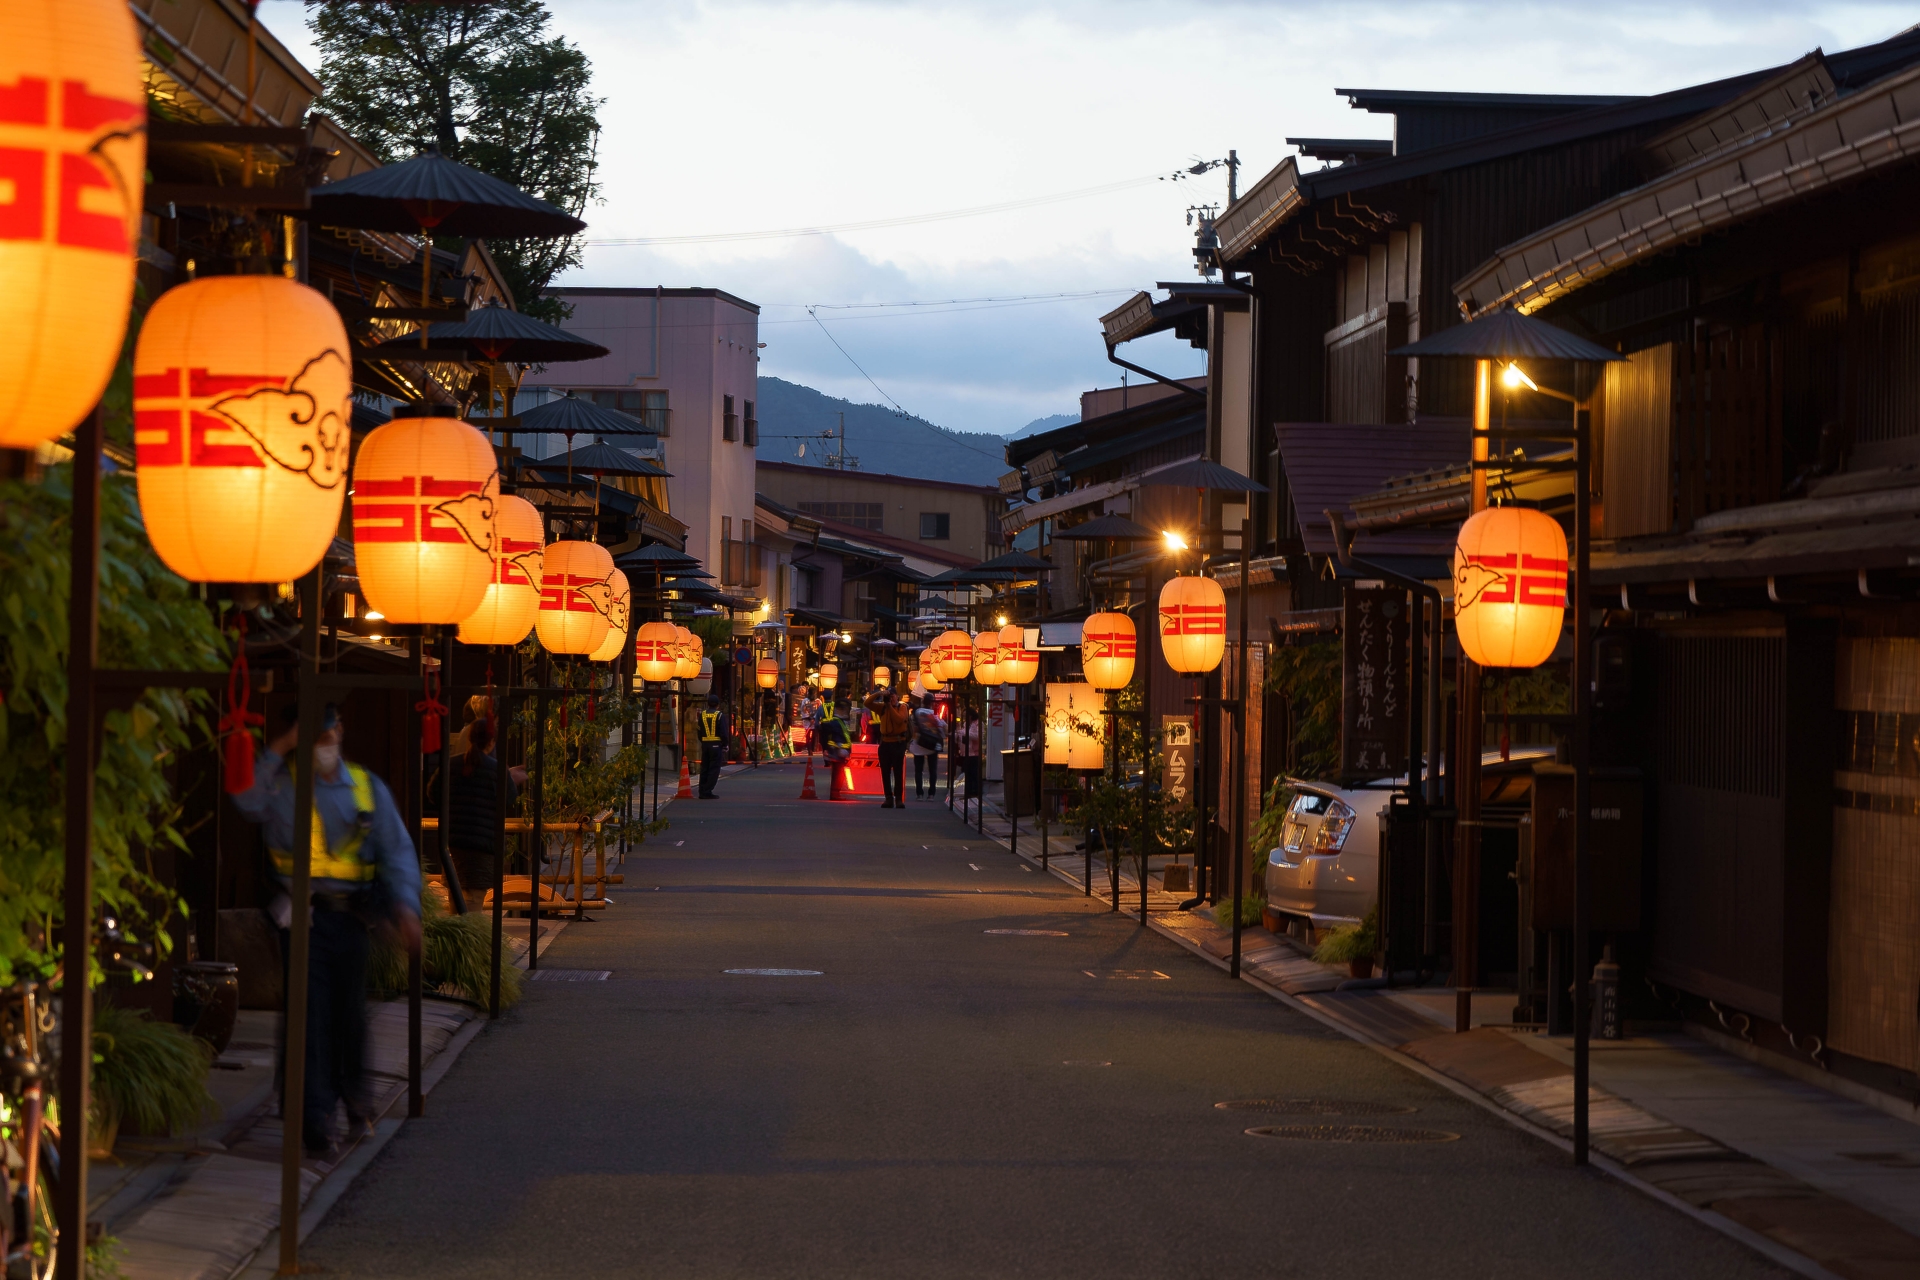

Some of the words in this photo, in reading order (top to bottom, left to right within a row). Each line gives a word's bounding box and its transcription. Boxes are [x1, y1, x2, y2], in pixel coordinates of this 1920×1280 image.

[792, 646, 804, 671] みそ
[1356, 598, 1375, 731] せんたく物預り所
[1383, 619, 1398, 717] くりーんらんど
[1557, 807, 1621, 820] ホー格納箱
